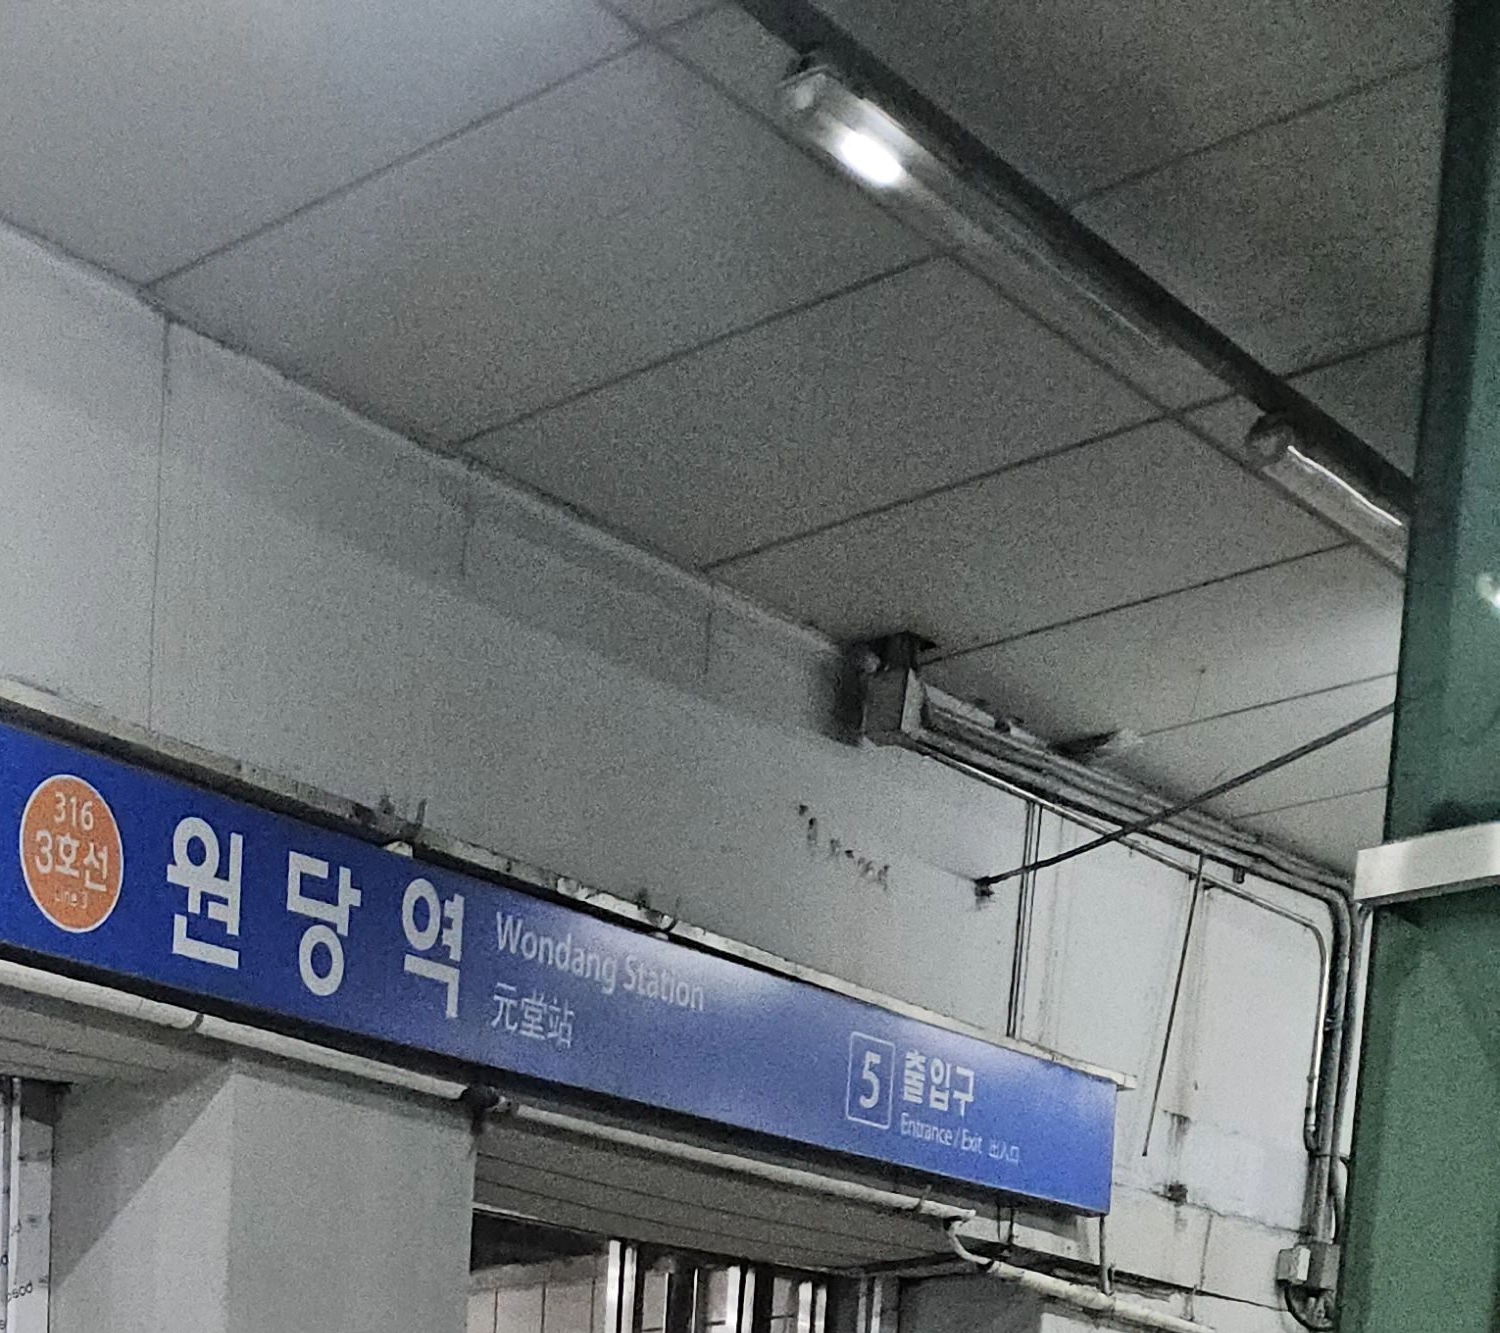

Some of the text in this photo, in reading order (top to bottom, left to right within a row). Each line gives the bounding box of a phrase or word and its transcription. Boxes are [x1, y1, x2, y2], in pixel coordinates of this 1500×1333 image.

[53, 791, 94, 831] 316
[34, 828, 108, 892] 3호선
[495, 911, 704, 1012] Wondang Station
[492, 981, 574, 1049] 元堂站
[860, 1049, 975, 1119] 5 출입구
[900, 1111, 953, 1146] Entrance
[961, 1128, 983, 1154] Exit
